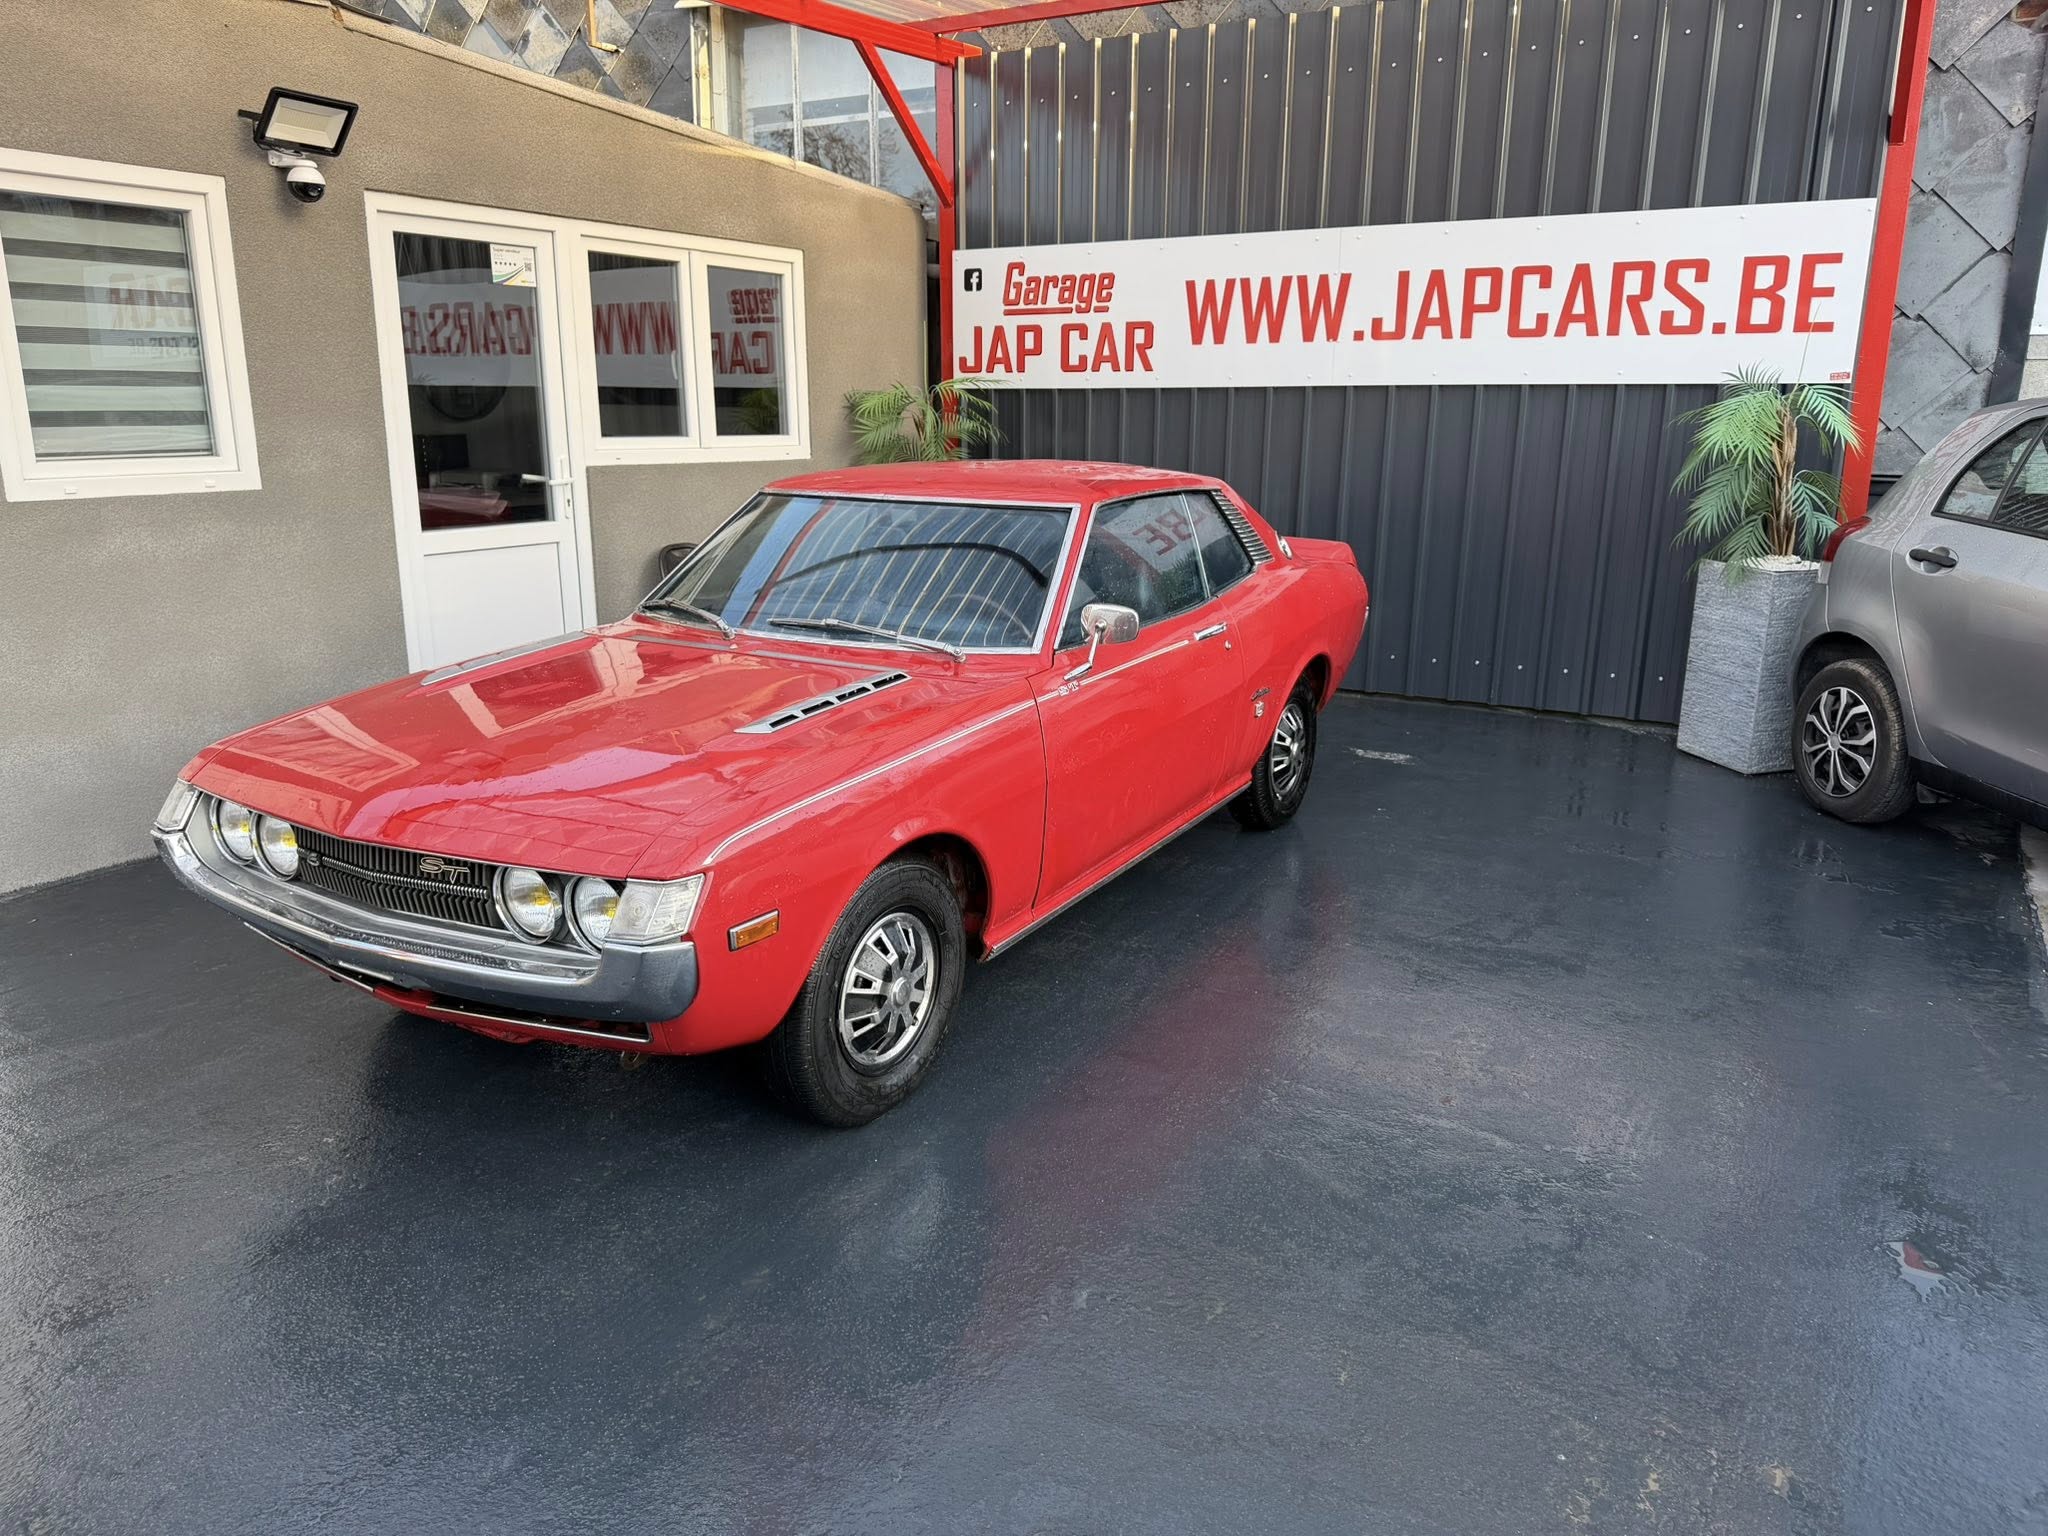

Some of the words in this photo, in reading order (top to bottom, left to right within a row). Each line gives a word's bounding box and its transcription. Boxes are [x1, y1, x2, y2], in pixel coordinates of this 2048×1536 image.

[1003, 261, 1116, 315] Garage
[1185, 252, 1844, 346] WWW.JAPCARS.BE
[959, 324, 1043, 374] JAP
[1060, 321, 1155, 373] CAR
[420, 856, 470, 884] ST
